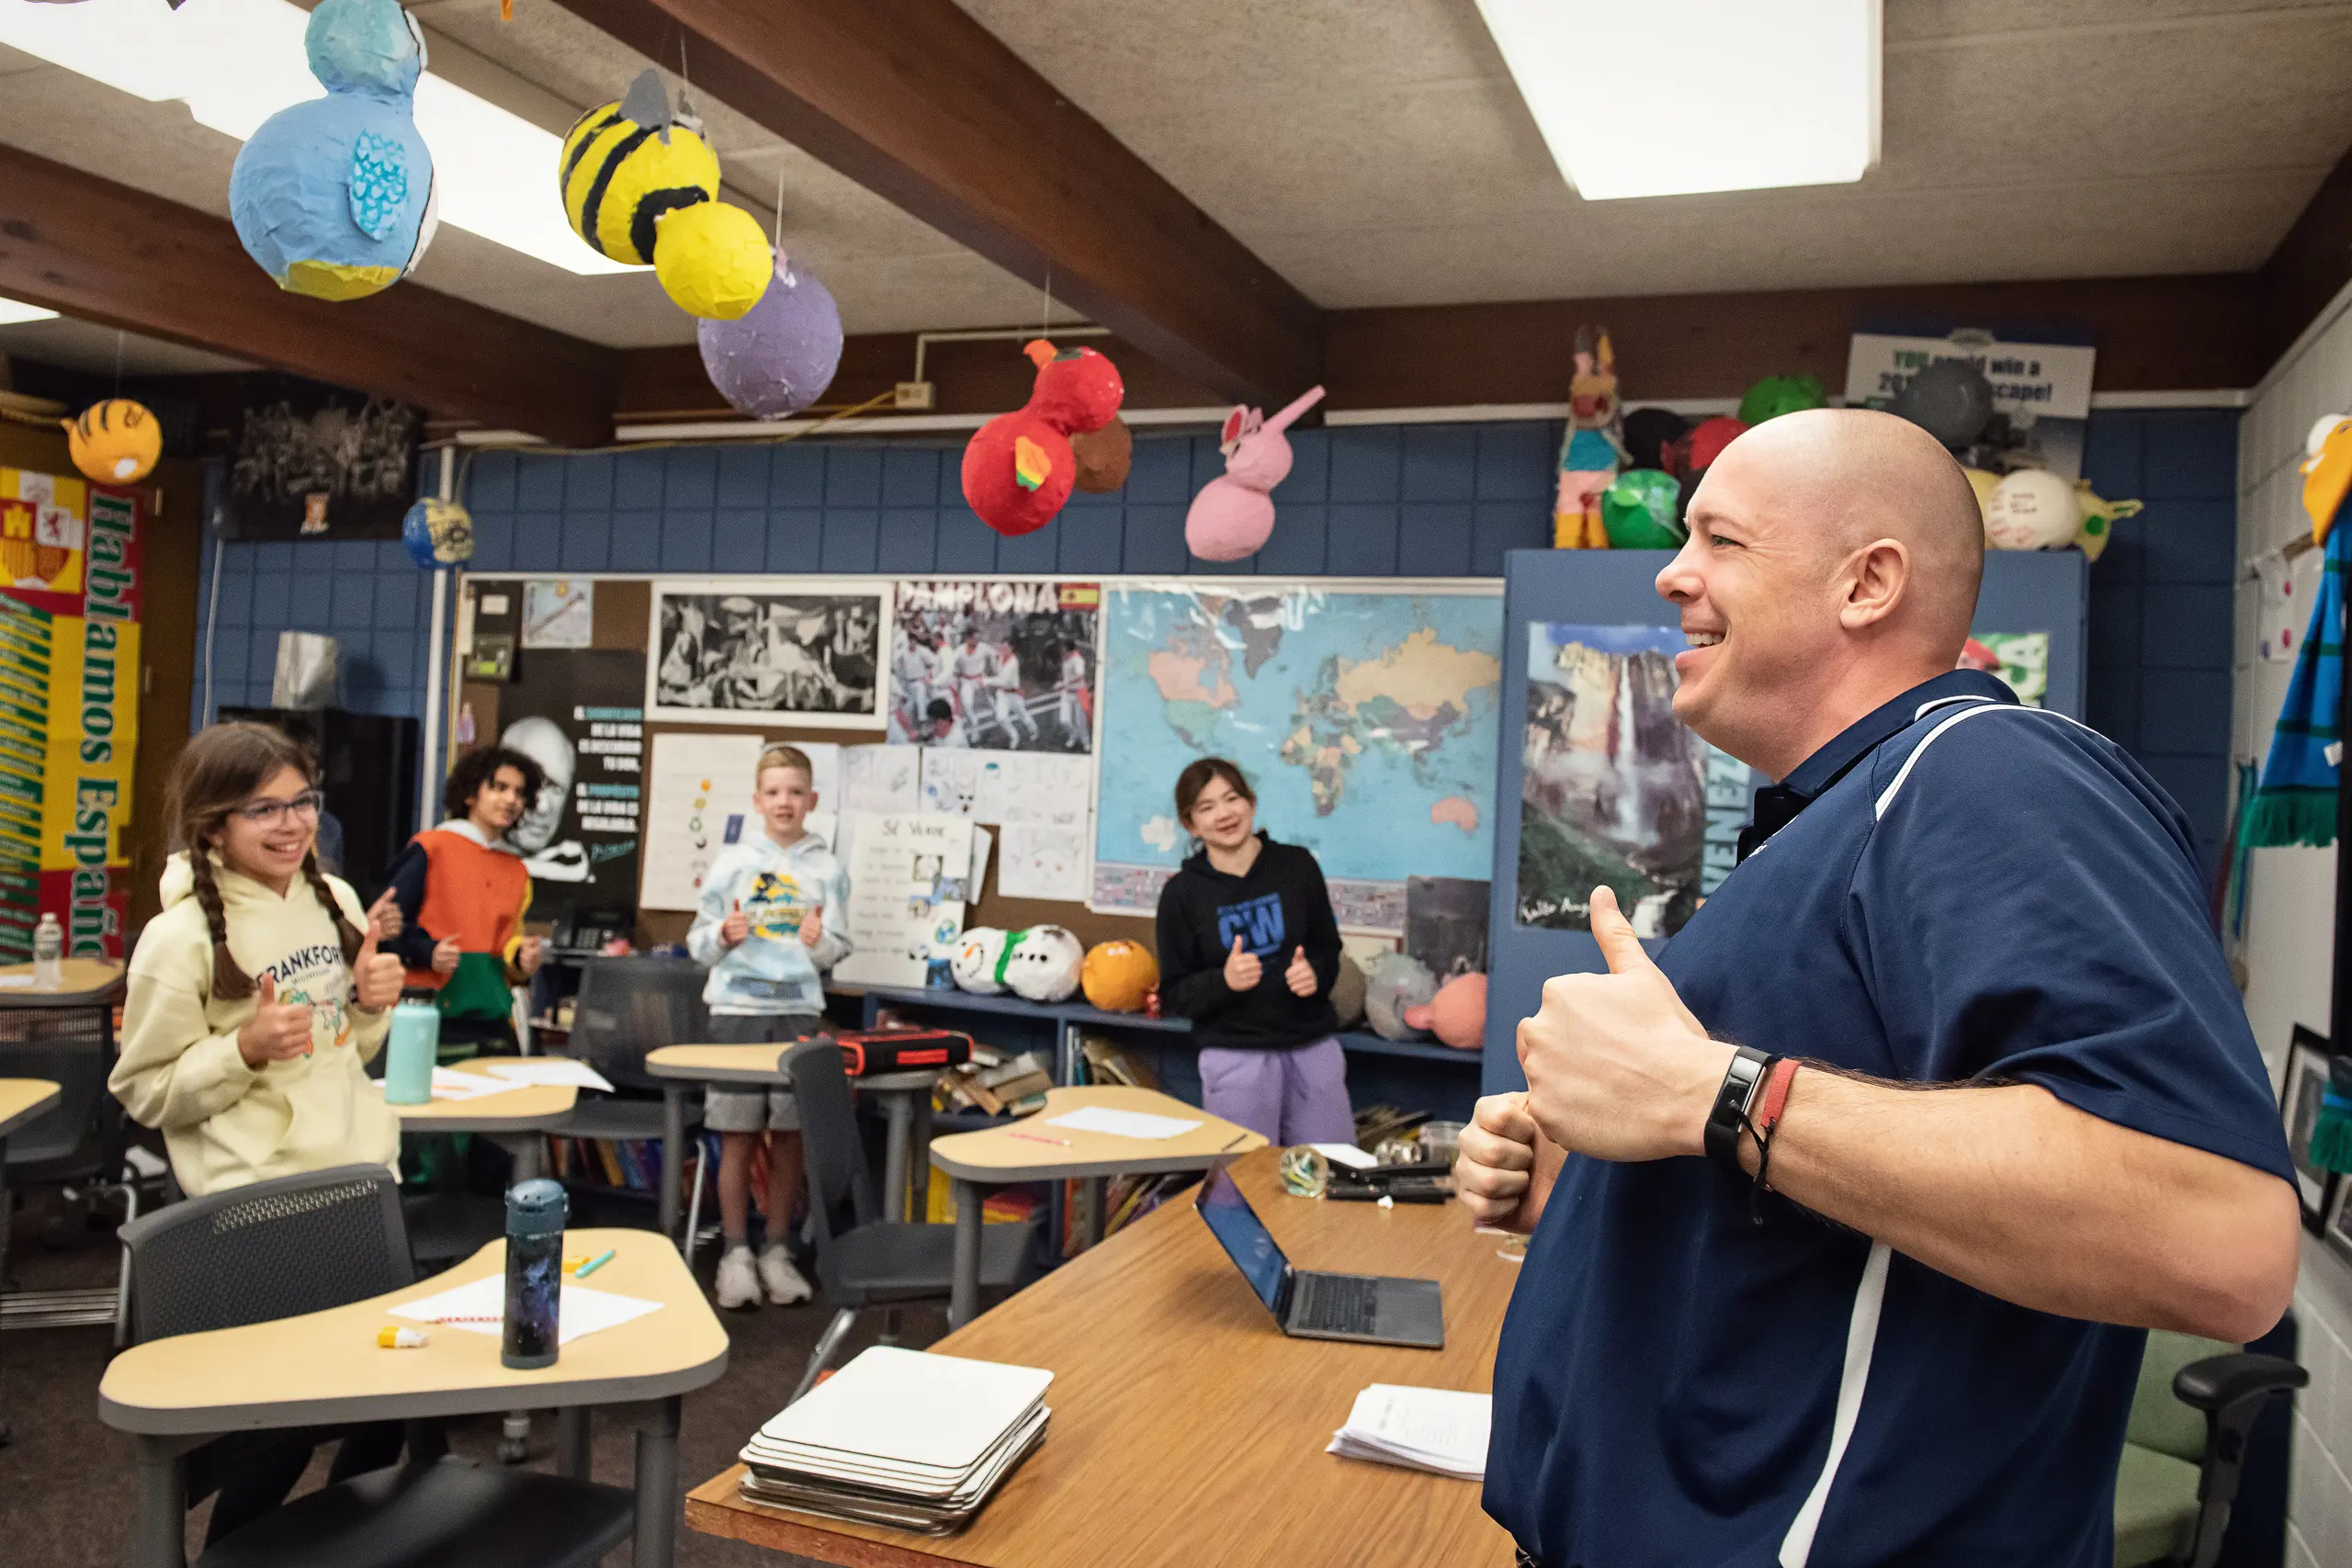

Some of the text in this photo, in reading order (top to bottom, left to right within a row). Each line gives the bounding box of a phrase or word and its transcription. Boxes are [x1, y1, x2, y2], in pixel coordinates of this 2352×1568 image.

[1995, 382, 2052, 401] cape!
[79, 492, 135, 763] Hablamos
[897, 581, 1059, 613] PAMPLONA
[1703, 744, 1749, 896] VENEZ
